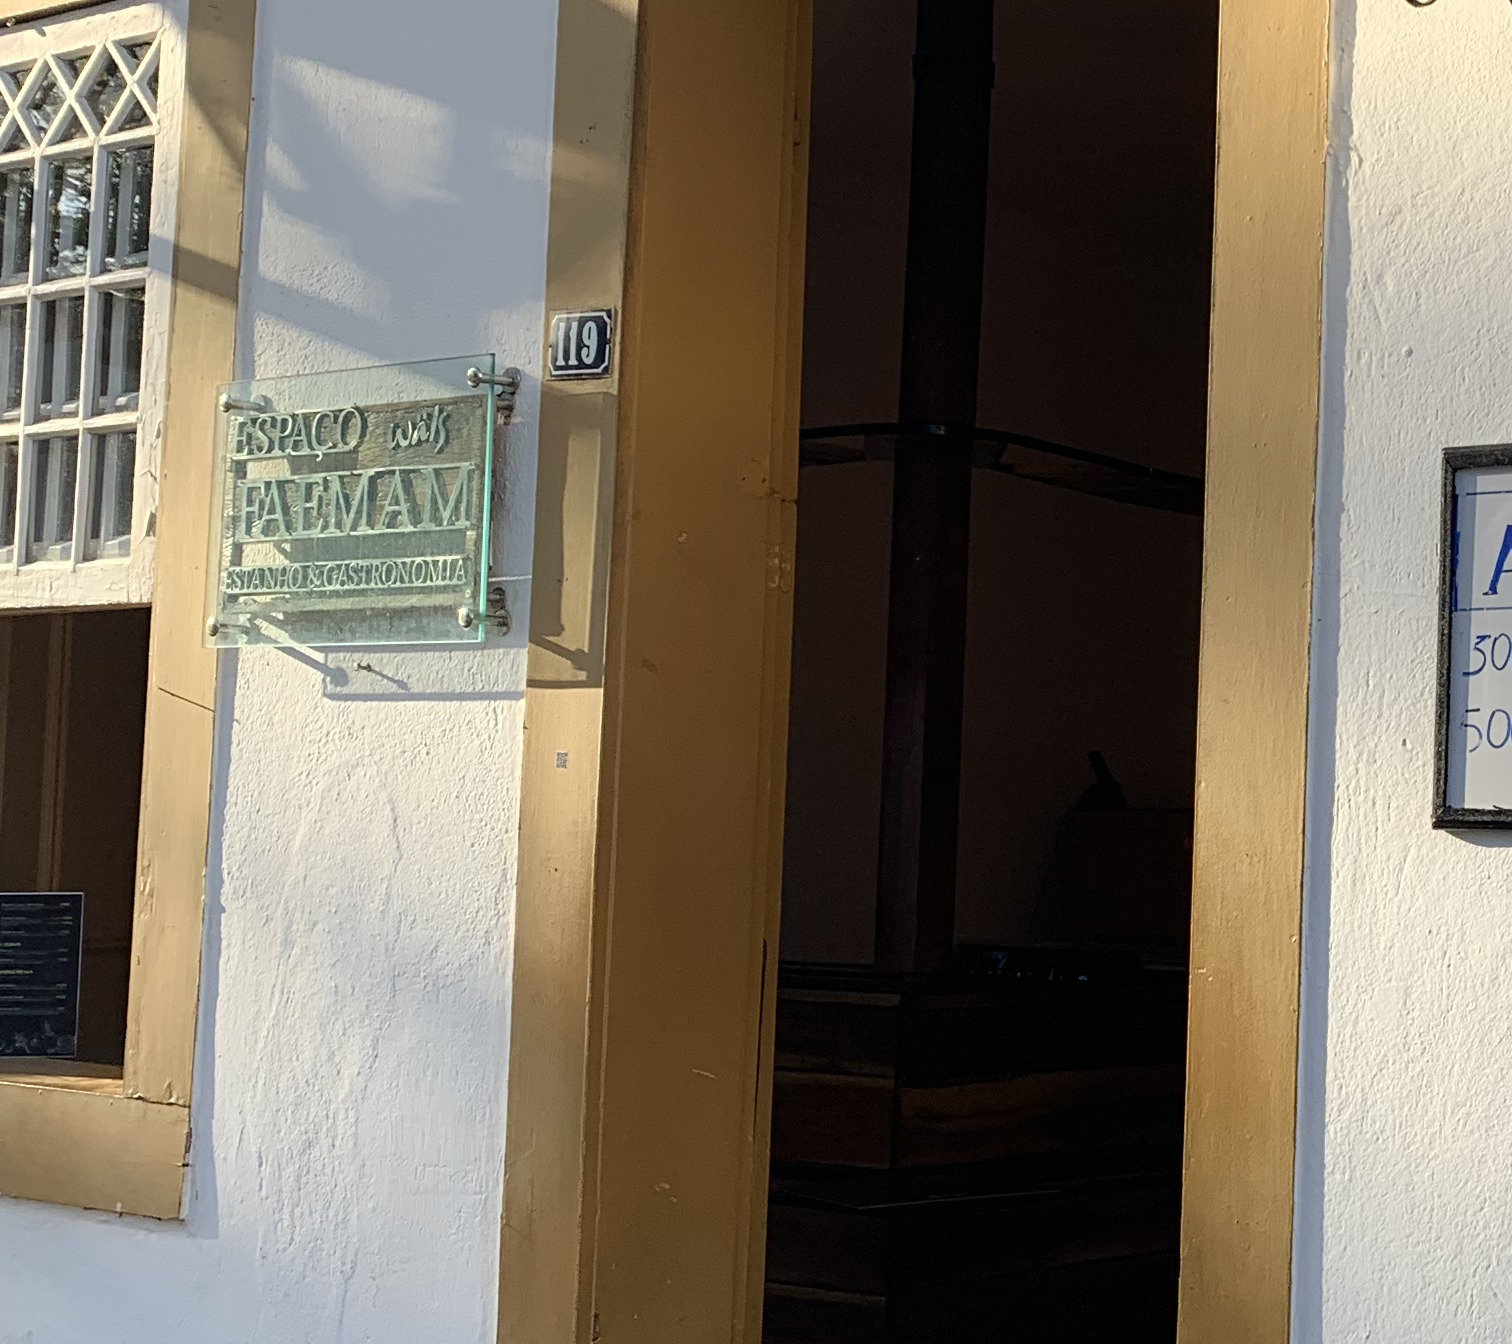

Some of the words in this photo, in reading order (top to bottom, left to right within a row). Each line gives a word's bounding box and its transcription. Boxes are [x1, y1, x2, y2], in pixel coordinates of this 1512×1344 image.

[555, 320, 599, 366] 119
[232, 407, 366, 462] ESPAÇO
[236, 463, 475, 543] FAEMAM
[222, 565, 302, 593] ESTANHO
[322, 556, 467, 592] GASTRONOMIA
